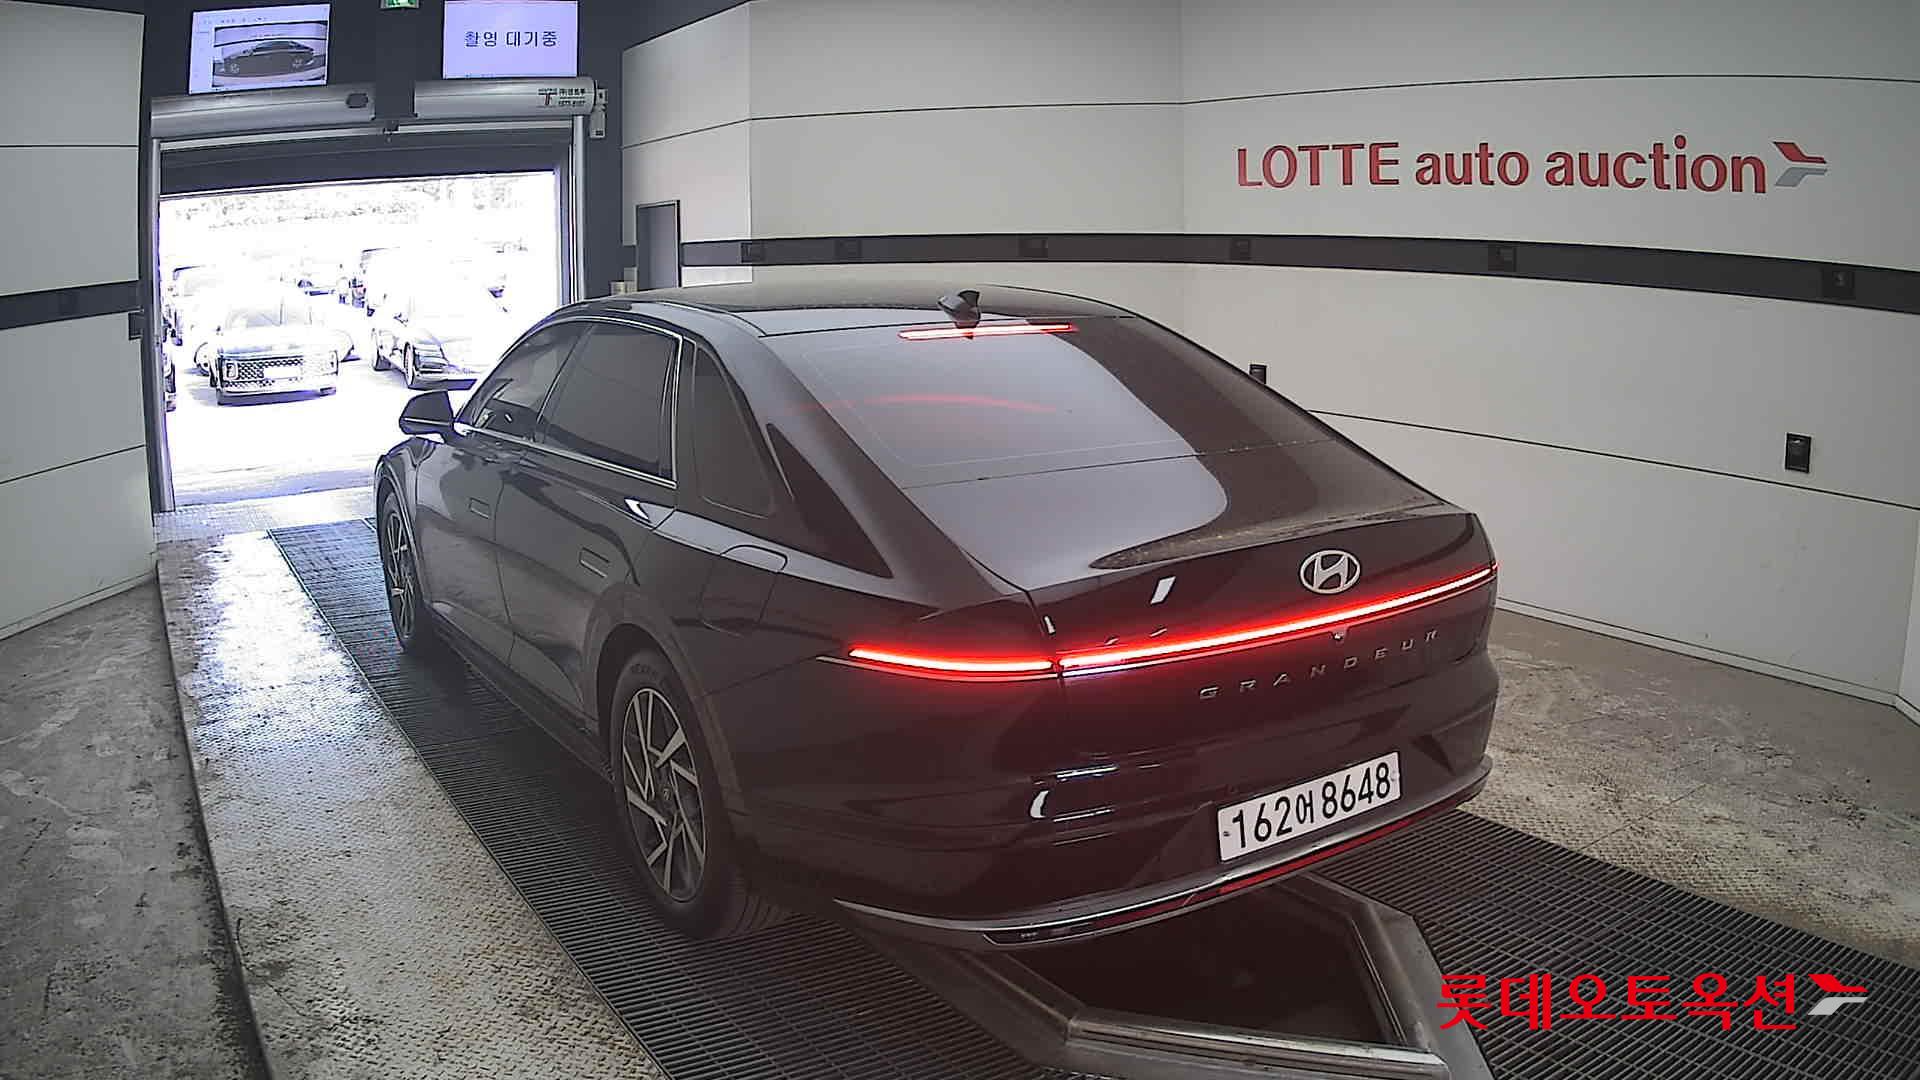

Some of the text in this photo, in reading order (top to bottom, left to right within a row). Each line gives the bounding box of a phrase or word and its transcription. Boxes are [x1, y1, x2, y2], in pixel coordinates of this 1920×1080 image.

[464, 31, 558, 48] 촬영 대기중
[1237, 134, 1767, 194] LOTTE auto auction
[1199, 629, 1439, 700] GRANDEUR
